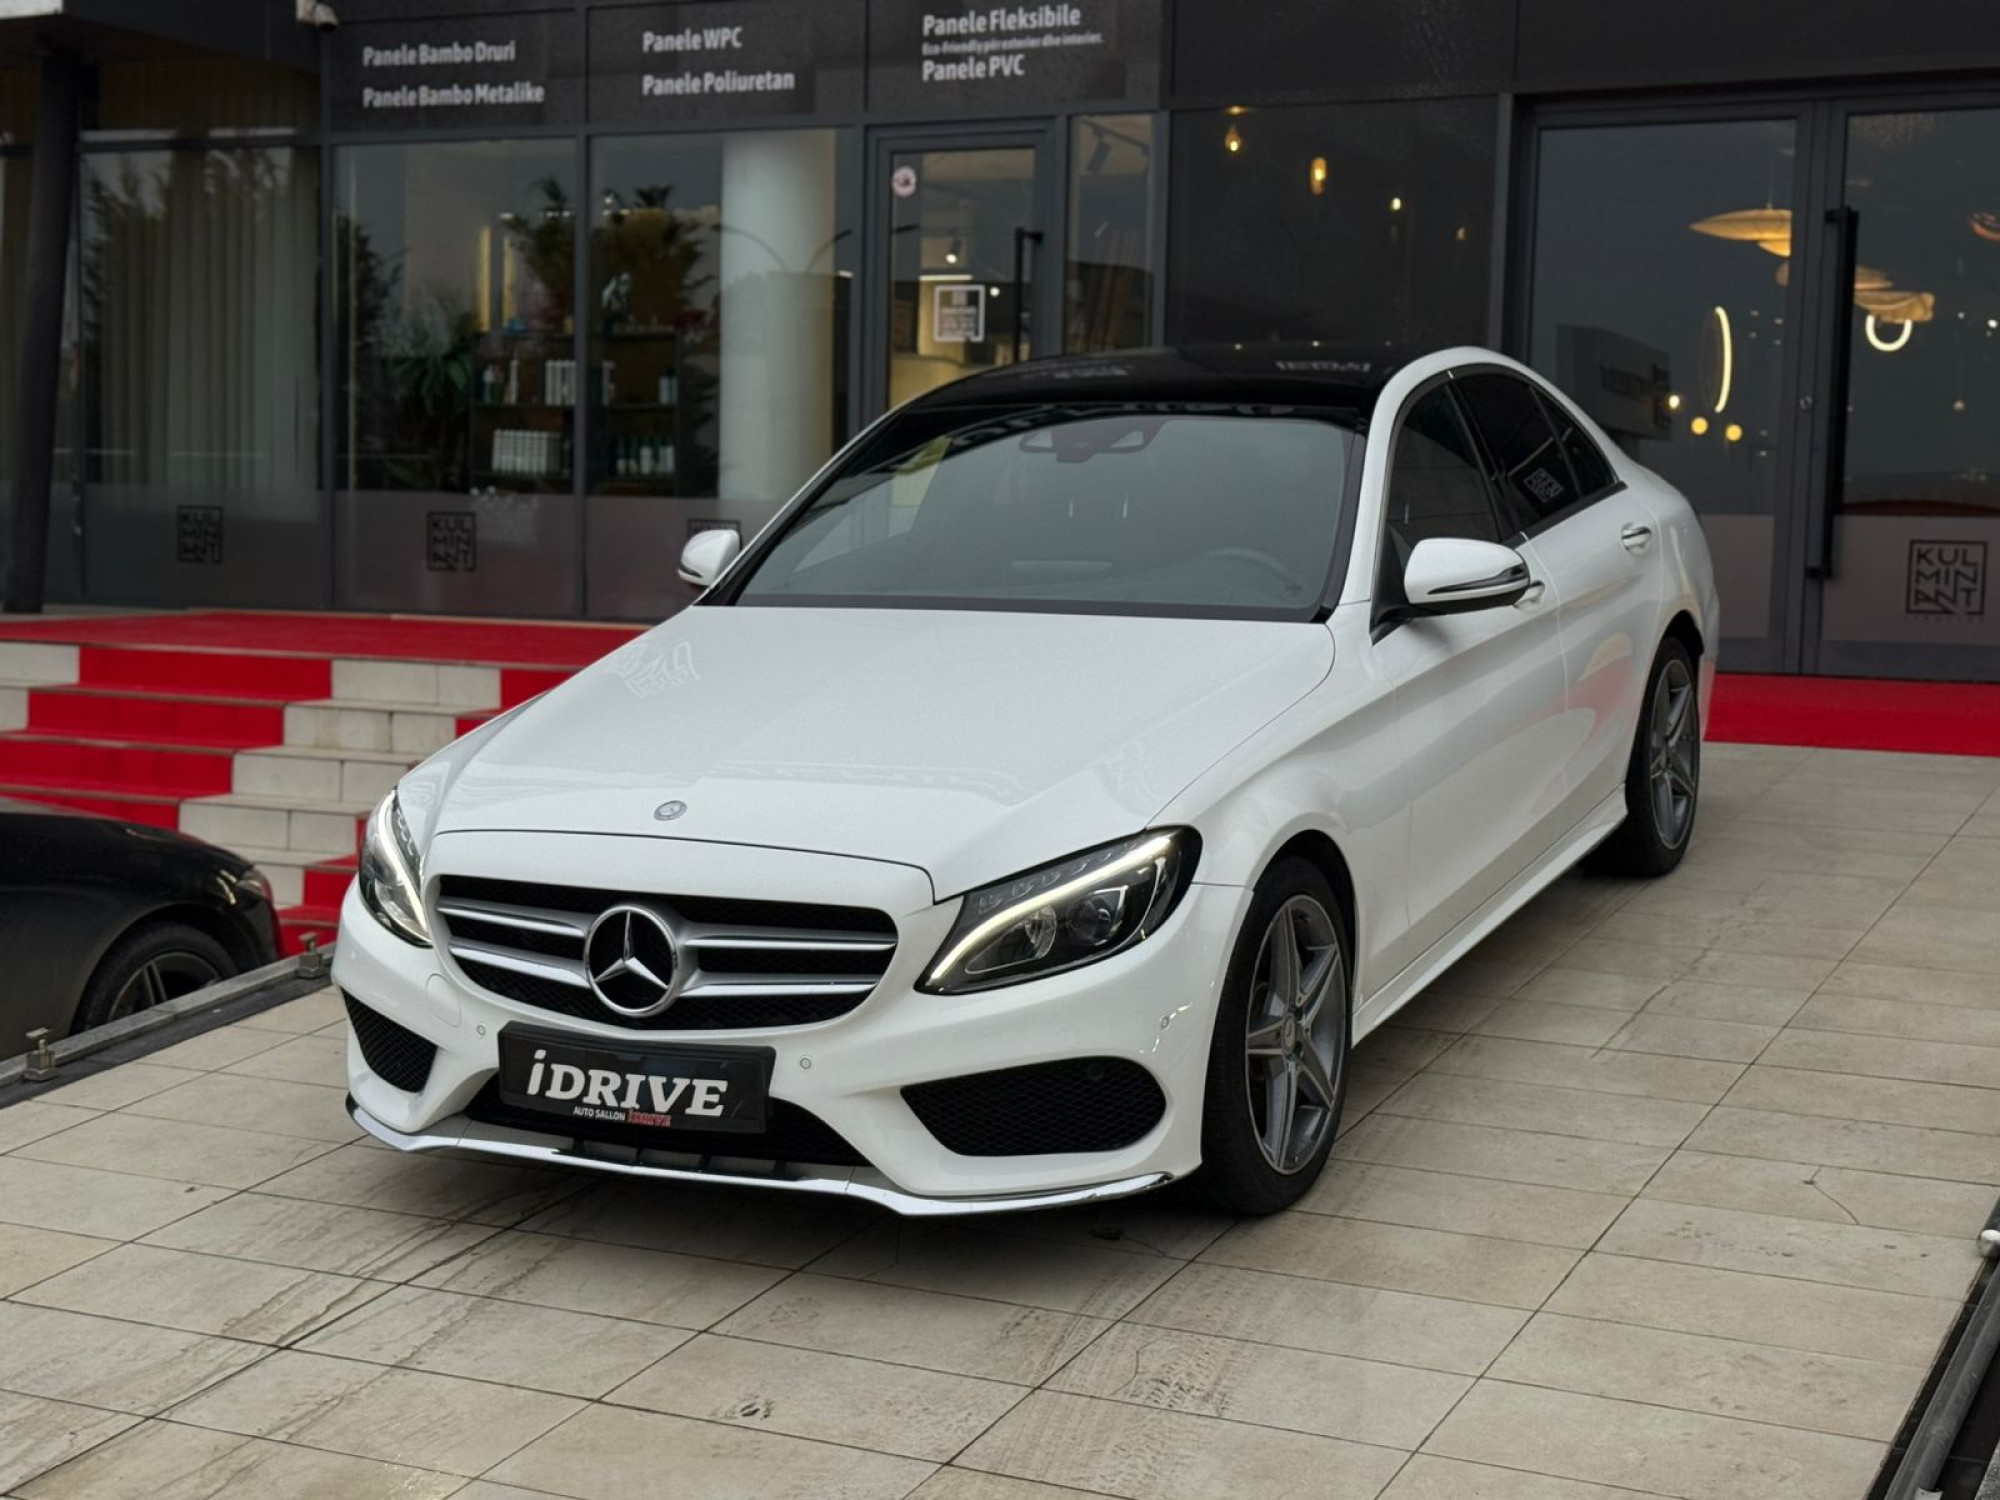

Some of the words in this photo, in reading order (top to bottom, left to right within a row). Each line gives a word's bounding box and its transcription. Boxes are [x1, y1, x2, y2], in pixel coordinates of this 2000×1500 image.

[922, 11, 987, 36] Panele
[989, 4, 1081, 31] Fleksibile
[362, 44, 416, 67] Panele
[419, 41, 474, 65] Bambo
[475, 39, 516, 63] Druri
[640, 31, 701, 53] Panele
[703, 26, 743, 49] WPC
[922, 57, 986, 82] Panele
[989, 54, 1025, 77] PVC
[362, 85, 416, 108] Panele
[419, 85, 474, 107] Bambo
[474, 81, 545, 105] Metalike
[640, 72, 701, 96] Panele
[703, 70, 796, 93] Poliuretan
[526, 1049, 728, 1117] iDRIVE
[573, 1106, 594, 1117] AUTO
[595, 1109, 626, 1121] SALLON
